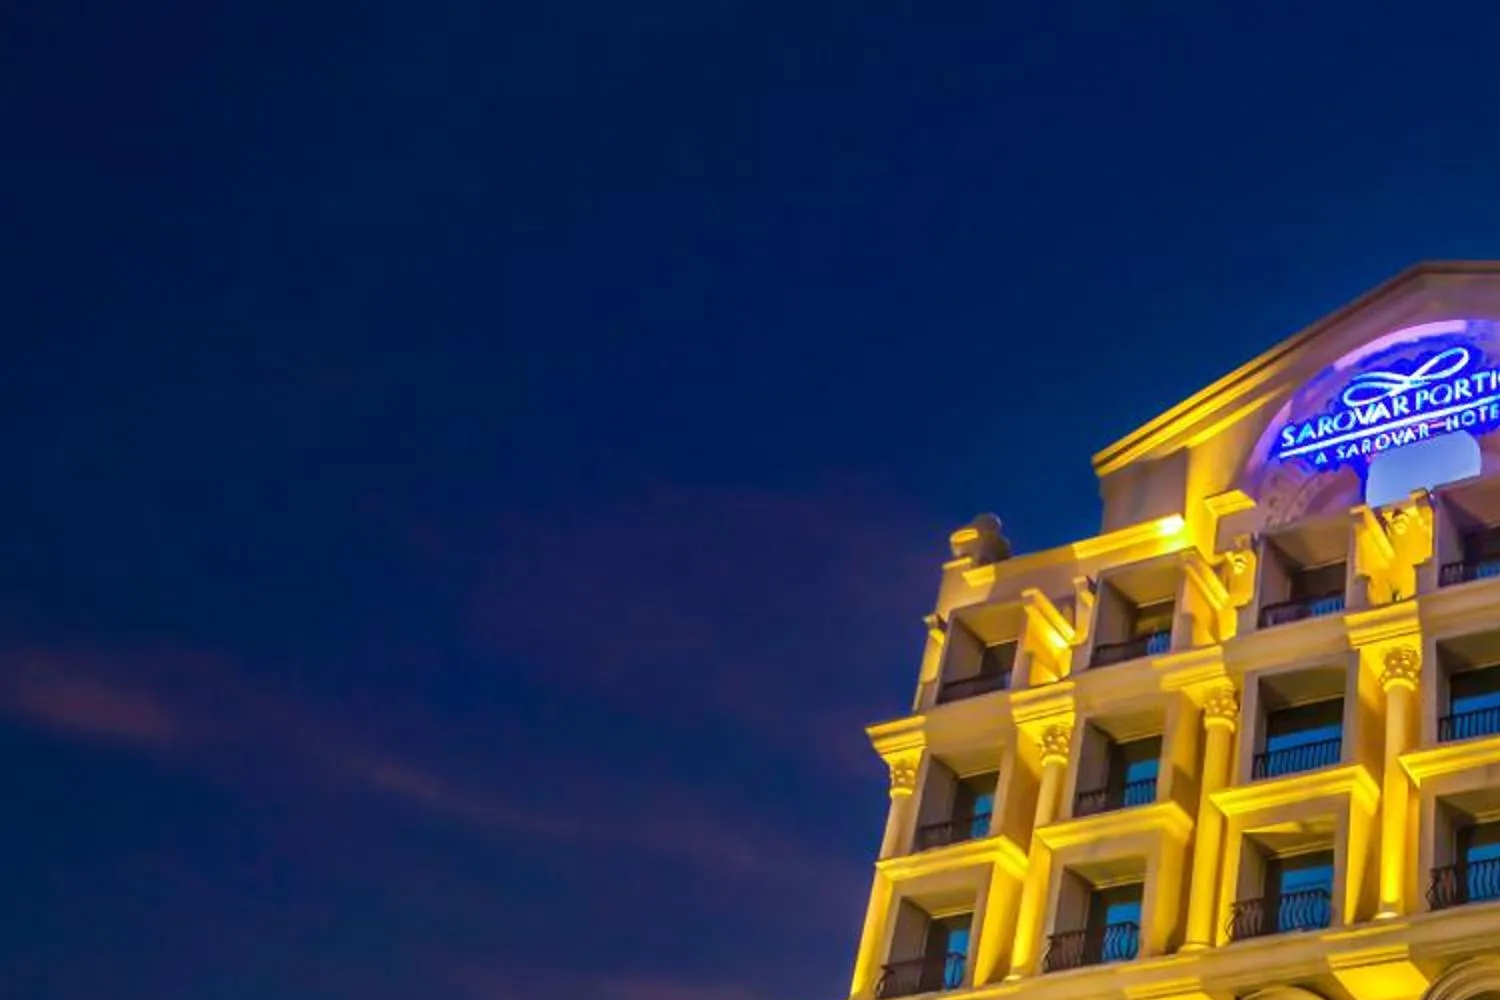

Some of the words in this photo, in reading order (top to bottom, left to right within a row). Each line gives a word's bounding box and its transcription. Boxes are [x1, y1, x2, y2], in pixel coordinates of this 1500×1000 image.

[1281, 395, 1410, 448] SAROVAR
[1315, 451, 1328, 465] A
[1336, 422, 1430, 460] SAROVAR
